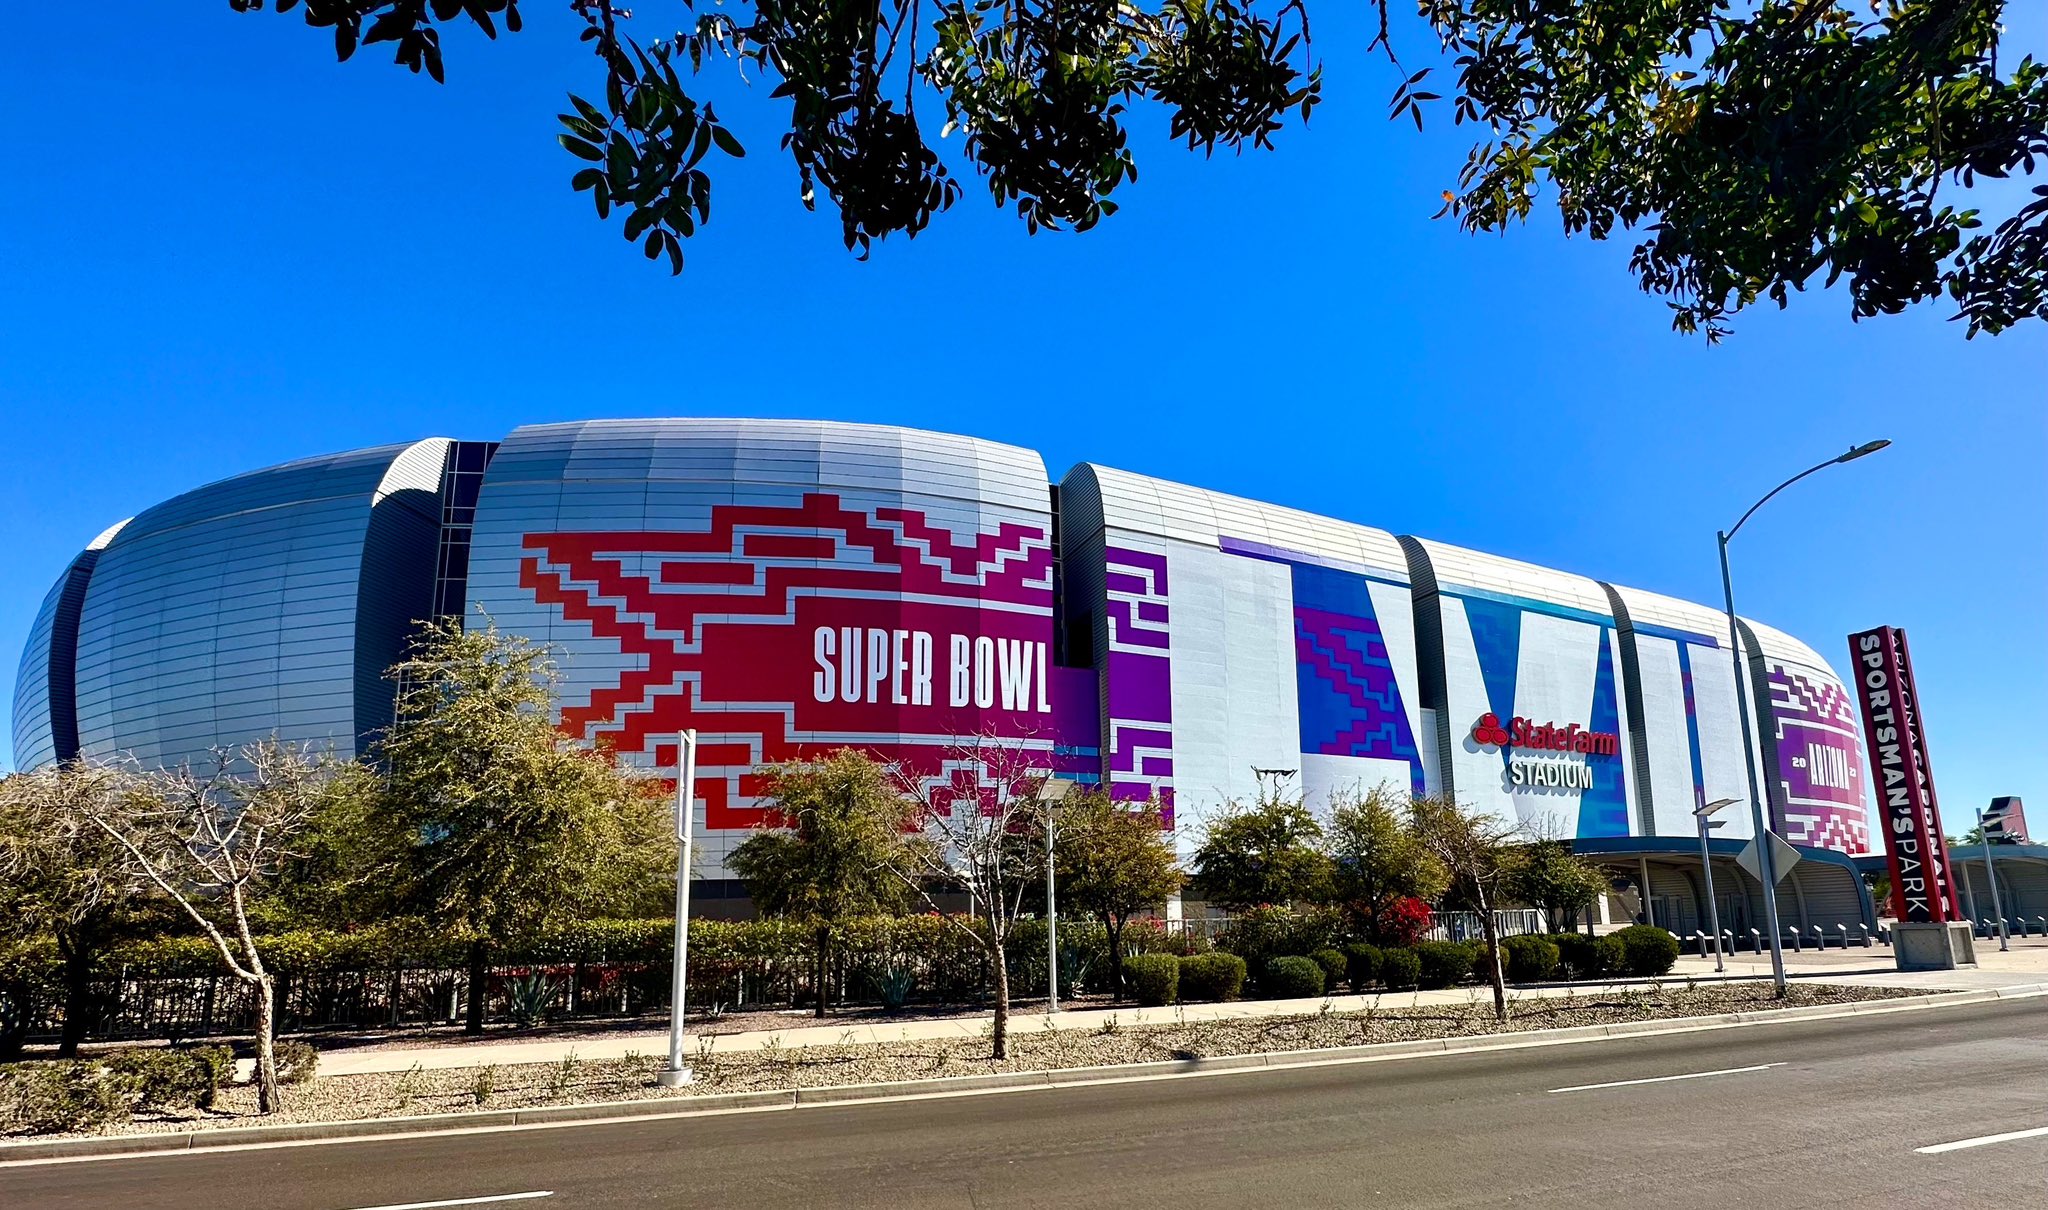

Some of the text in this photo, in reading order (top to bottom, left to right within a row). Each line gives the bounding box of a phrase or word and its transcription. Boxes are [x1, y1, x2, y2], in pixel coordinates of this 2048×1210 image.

[814, 626, 1051, 713] SUPER BOWL
[1891, 634, 1918, 743] ARIZONA
[1512, 762, 1593, 789] STADIUM
[1792, 757, 1807, 768] 20
[1809, 743, 1850, 790] ARIZONA
[1859, 634, 1930, 913] SPORTSMAN'S PARK
